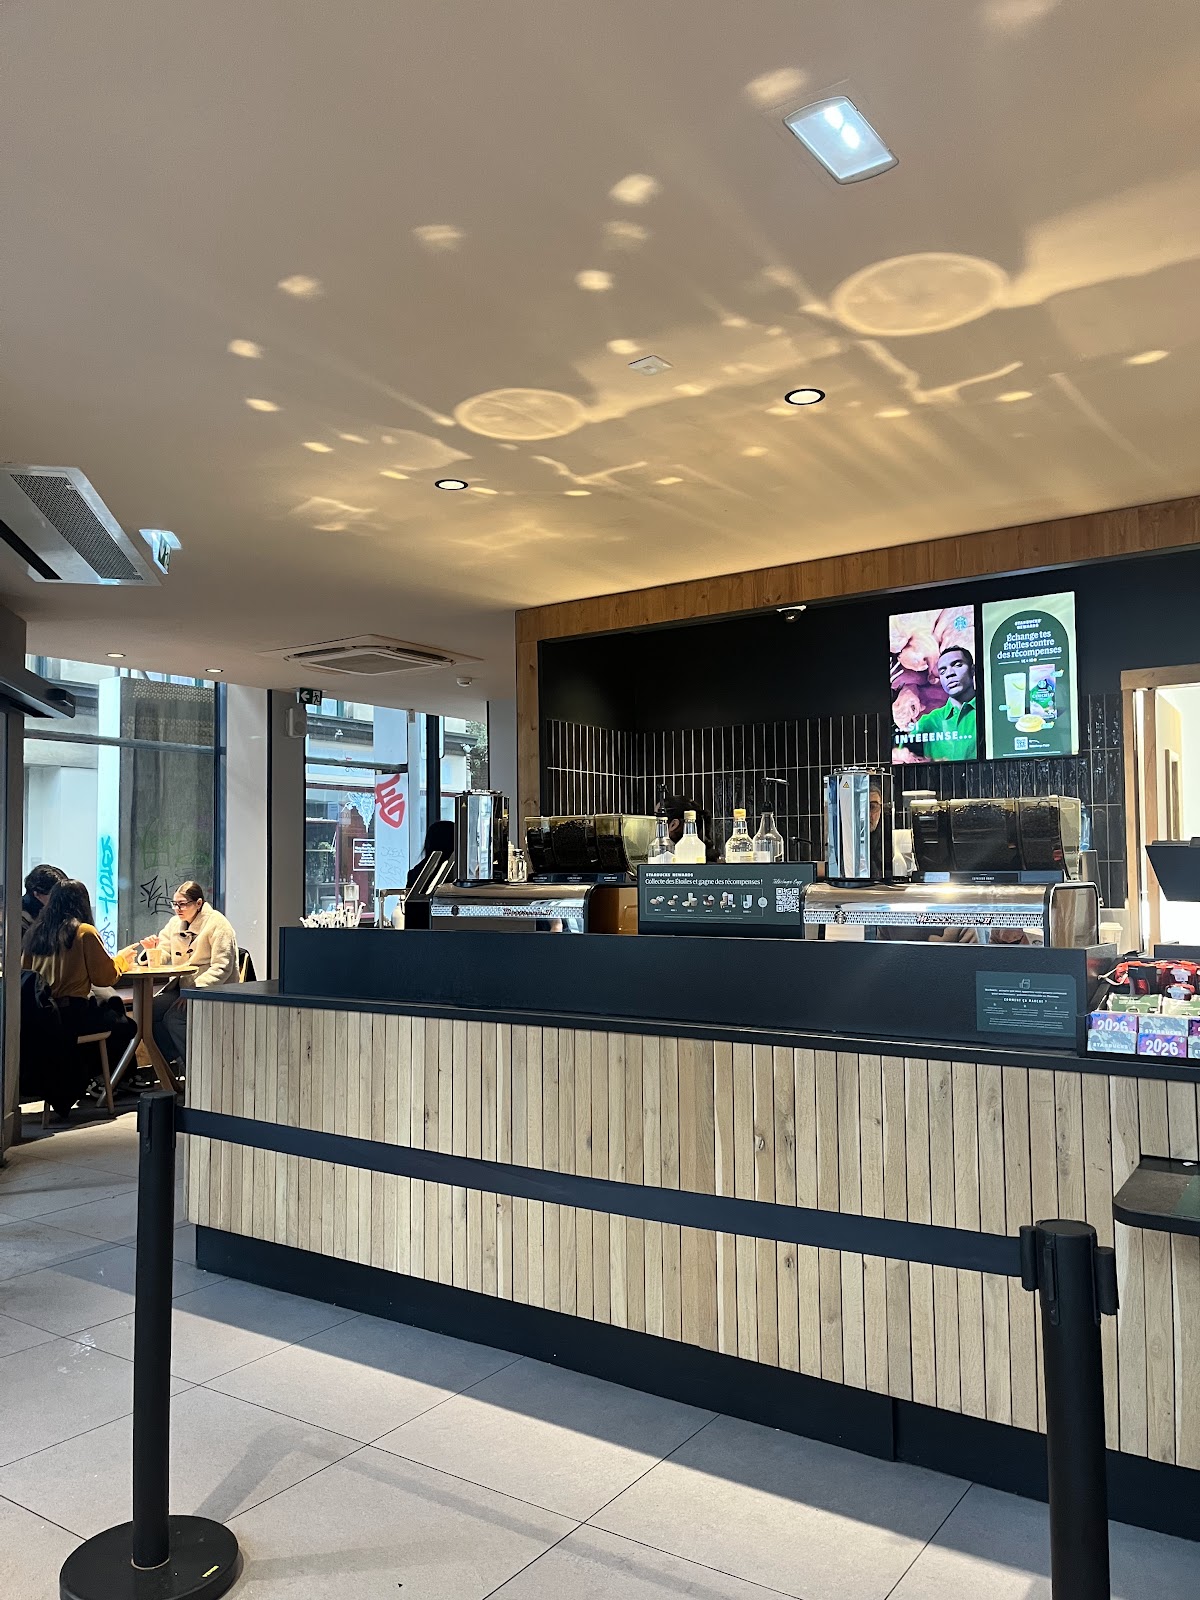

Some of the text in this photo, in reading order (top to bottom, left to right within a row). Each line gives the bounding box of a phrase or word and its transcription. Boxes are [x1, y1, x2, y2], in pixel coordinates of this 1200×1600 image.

[1006, 630, 1052, 642] Échange tes
[1003, 638, 1055, 651] Étoiles contre
[996, 646, 1062, 659] des récompenses
[894, 730, 973, 744] INTEEENSE...
[674, 877, 693, 885] Étoiles
[697, 879, 715, 887] gagne
[724, 878, 761, 887] récompenses
[1097, 1018, 1129, 1032] 2026
[1145, 1038, 1179, 1056] 2026
